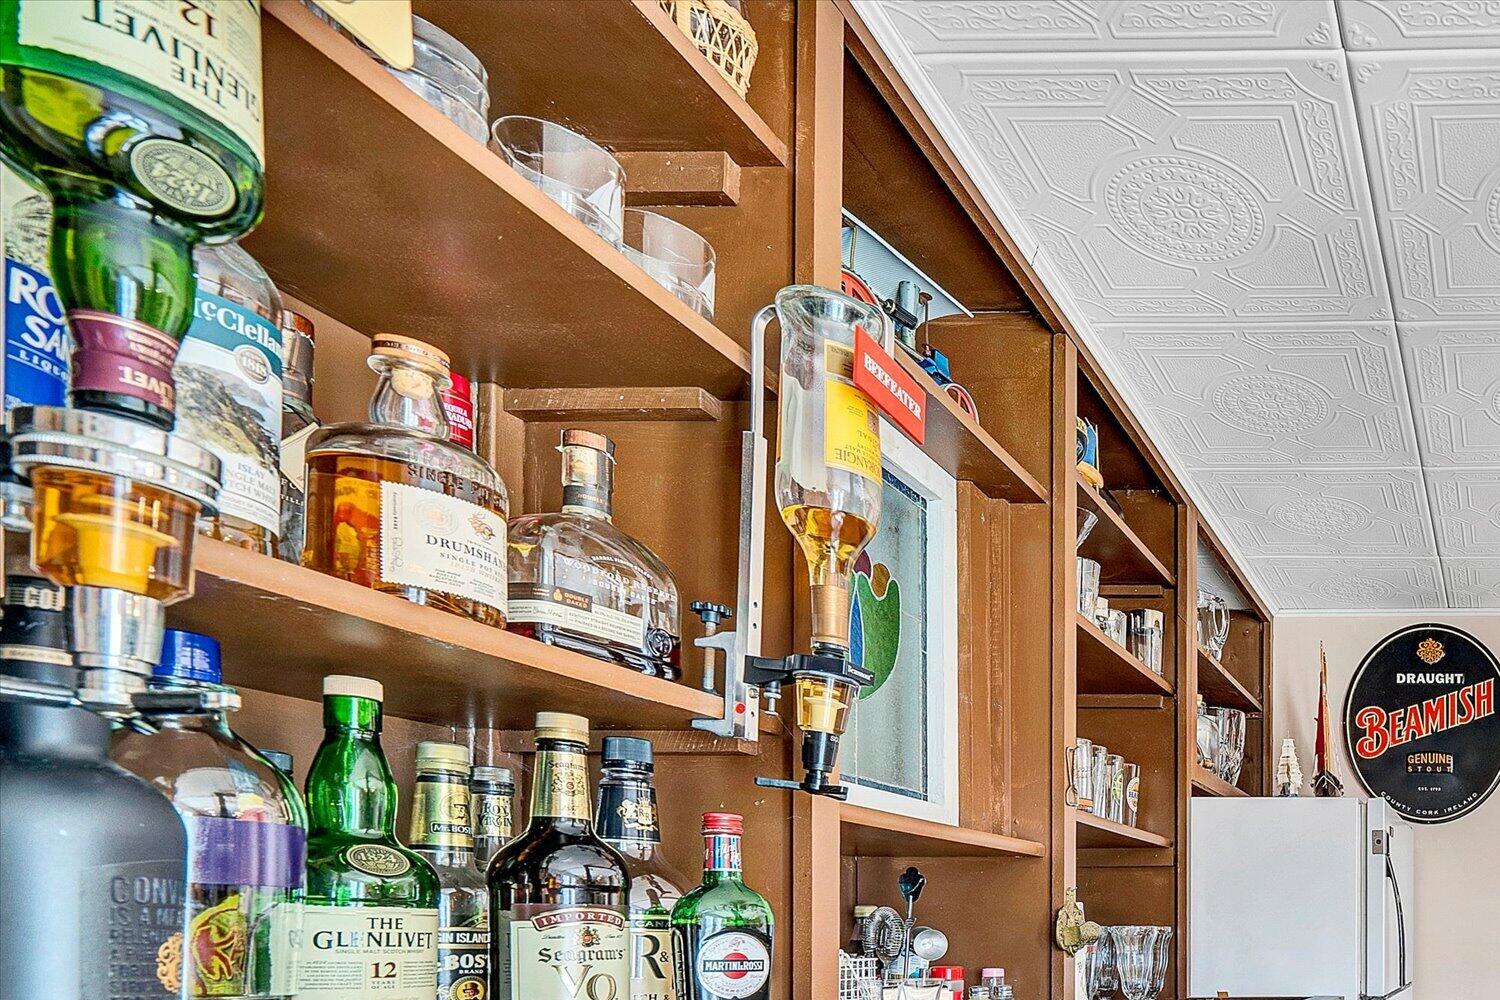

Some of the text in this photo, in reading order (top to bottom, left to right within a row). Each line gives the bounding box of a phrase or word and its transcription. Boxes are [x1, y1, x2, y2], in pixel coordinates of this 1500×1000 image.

[864, 352, 922, 422] BEEFEATER
[440, 552, 476, 567] SINGLE
[564, 592, 589, 603] DOUBLE
[1396, 673, 1464, 684] DRAUGHT
[1355, 677, 1495, 760] BEAMISH
[1408, 753, 1453, 764] GENUINE
[1408, 766, 1453, 774] STOUT
[1381, 791, 1411, 812] COUNTY
[1444, 792, 1477, 813] IRELAND
[367, 917, 404, 929] THE
[541, 911, 622, 926] IMPORTED
[313, 930, 433, 950] GLENLIVET
[456, 932, 490, 943] ISLAND
[538, 947, 626, 963] Seagram's
[370, 962, 397, 978] 12
